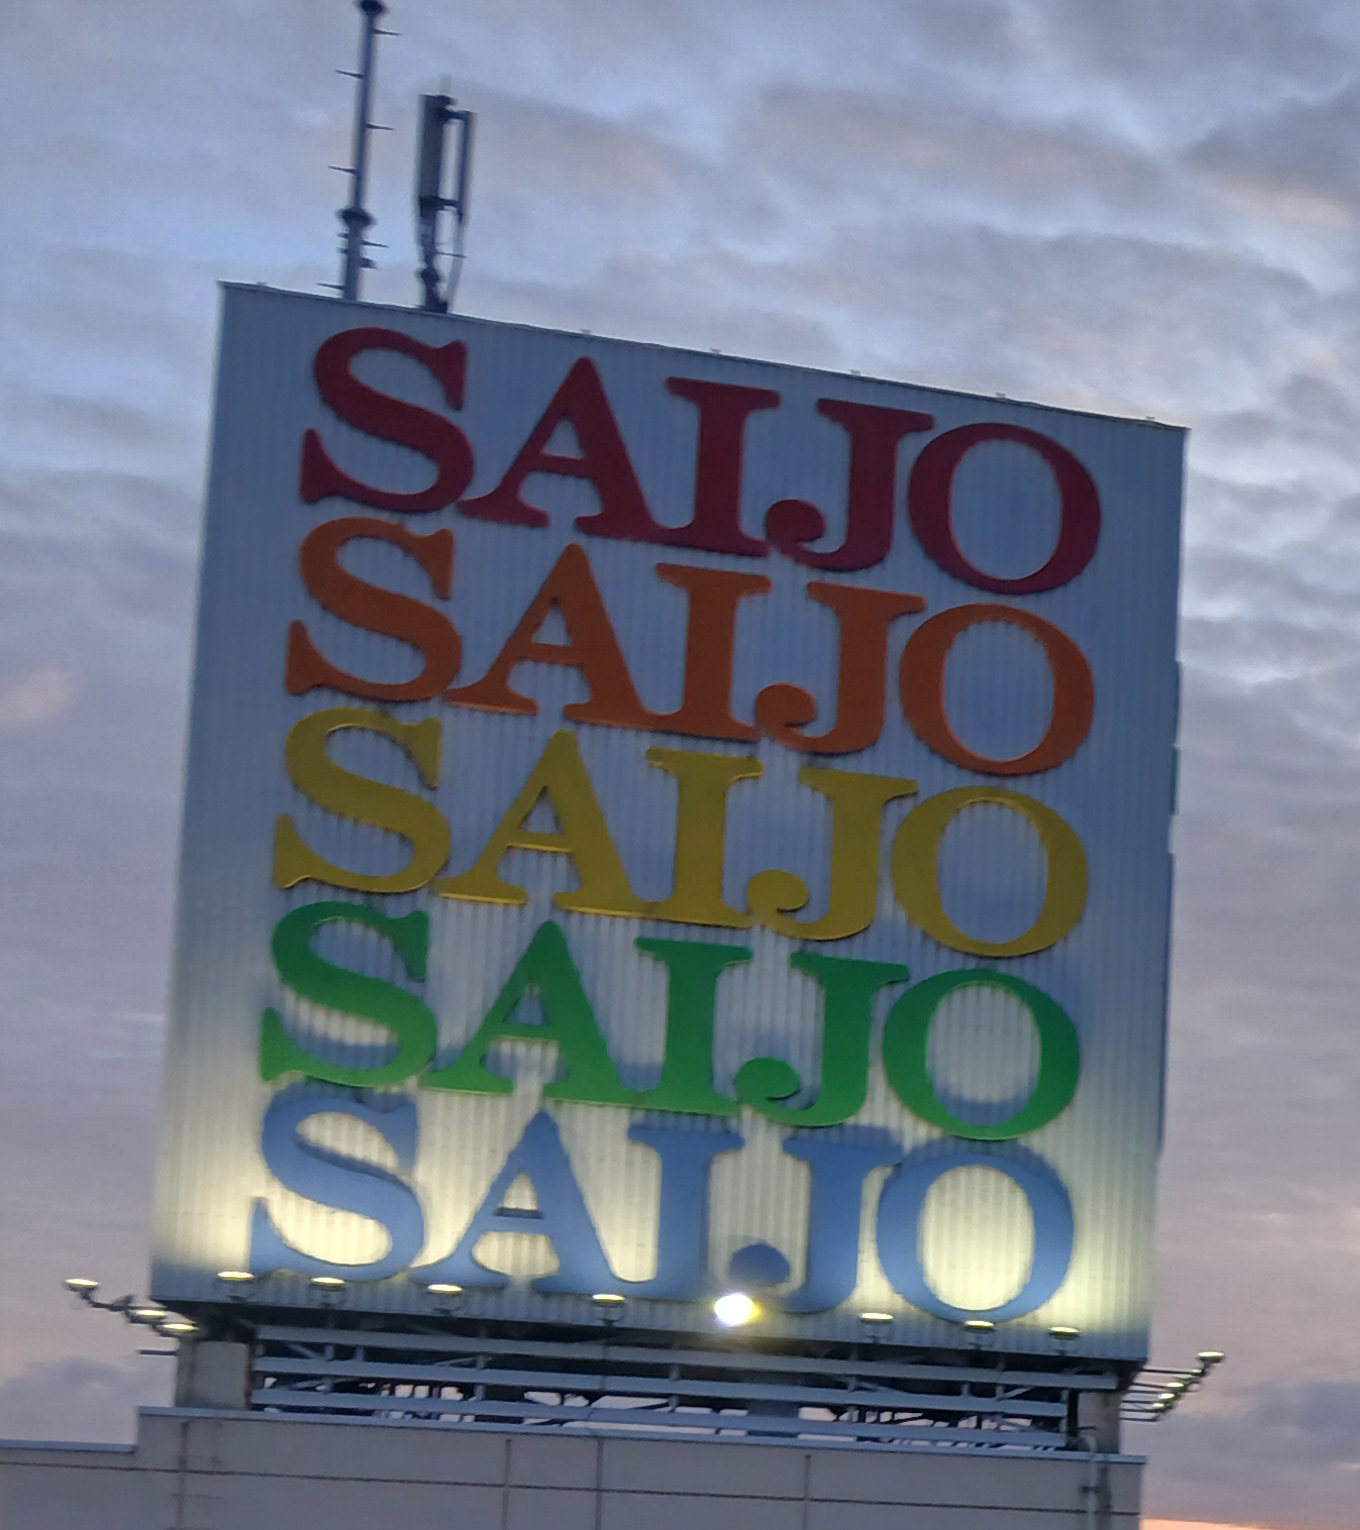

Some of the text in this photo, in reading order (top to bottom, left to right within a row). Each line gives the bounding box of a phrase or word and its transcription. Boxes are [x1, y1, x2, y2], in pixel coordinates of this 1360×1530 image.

[302, 327, 1101, 593] SAIJO
[286, 516, 1094, 775] SAIJO
[273, 708, 1088, 956] SAIJO
[260, 901, 1080, 1140] SAIJO
[250, 1093, 1075, 1321] SAIJO
